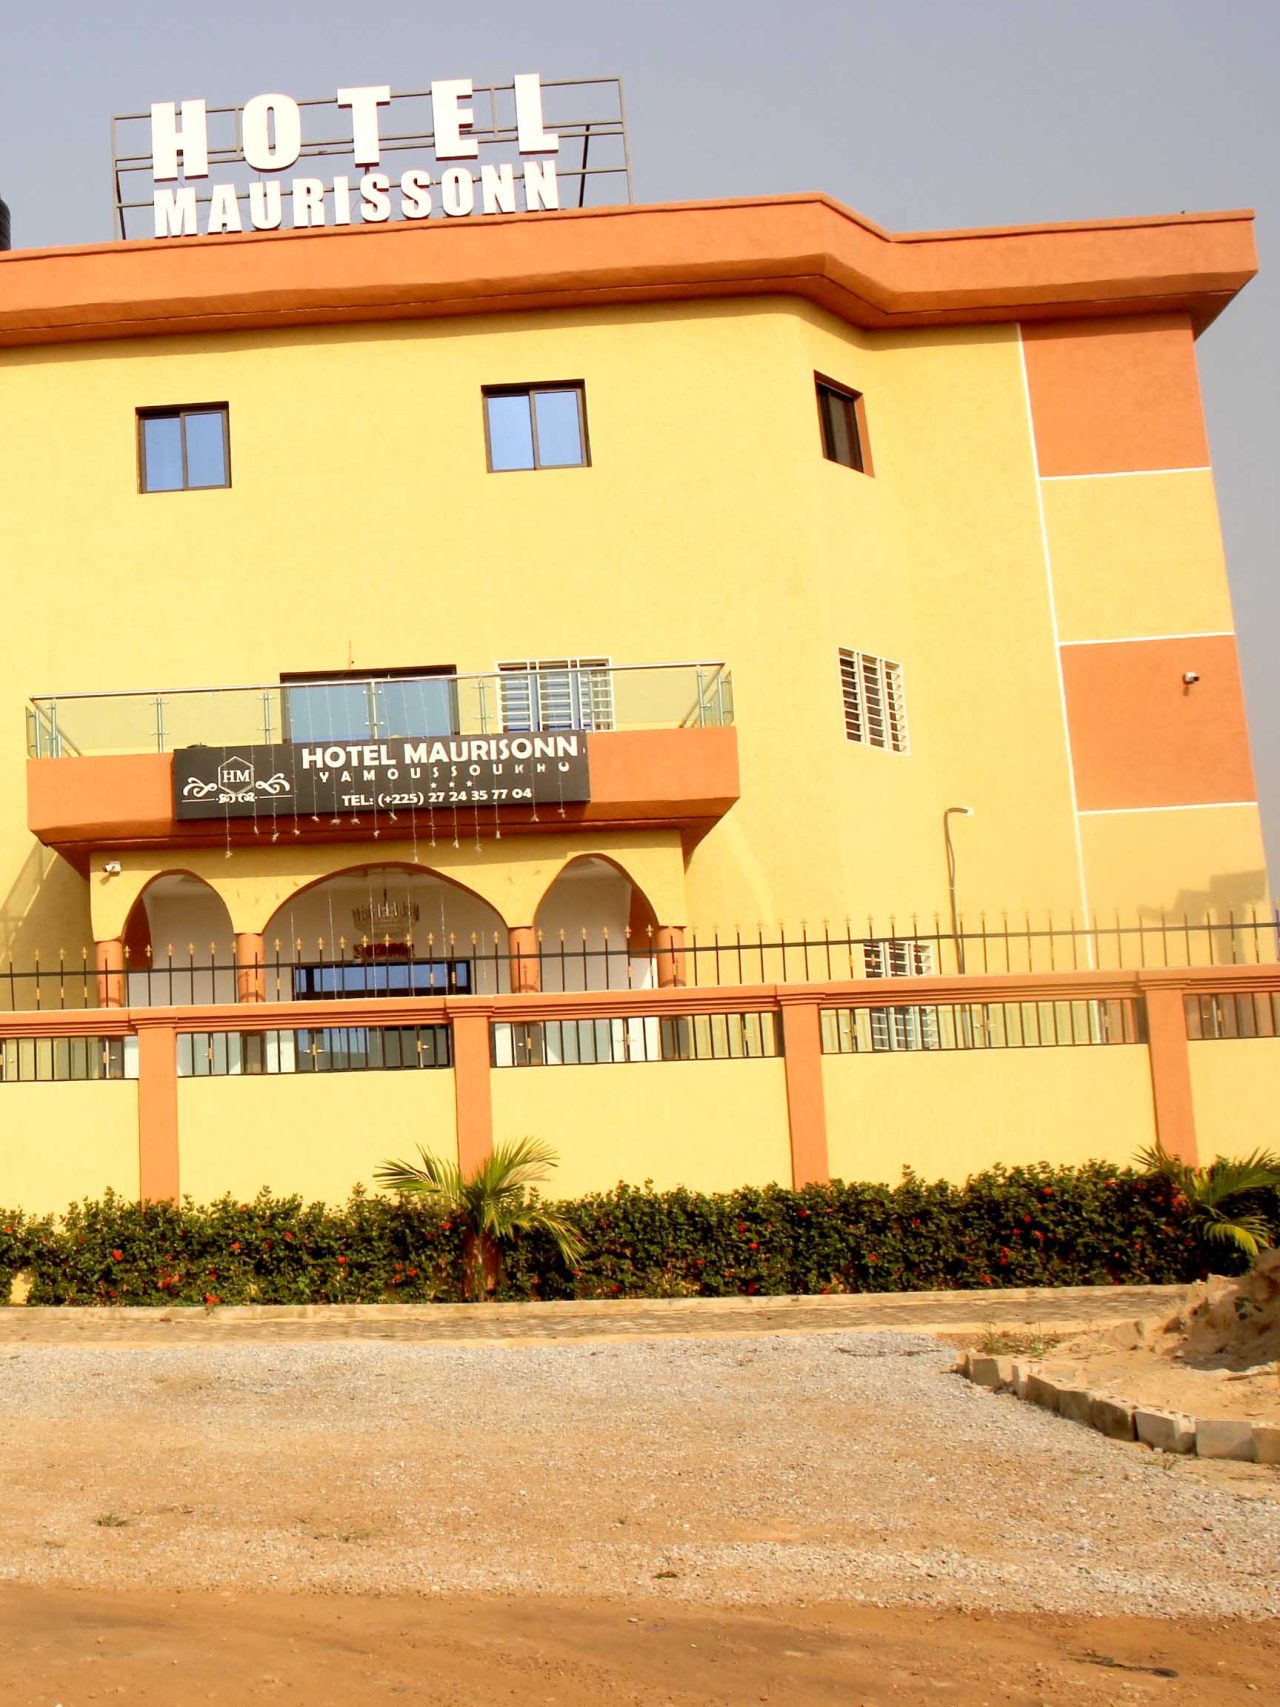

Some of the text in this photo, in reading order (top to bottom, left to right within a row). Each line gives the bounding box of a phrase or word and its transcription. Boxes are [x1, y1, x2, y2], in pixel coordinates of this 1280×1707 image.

[150, 73, 560, 182] HOTEL
[153, 159, 559, 239] MAURISSONN
[301, 735, 578, 769] HOTEL MAURISONN
[222, 769, 250, 783] HM
[341, 788, 532, 807] TEL: (+225) 27 24 35 77 04
